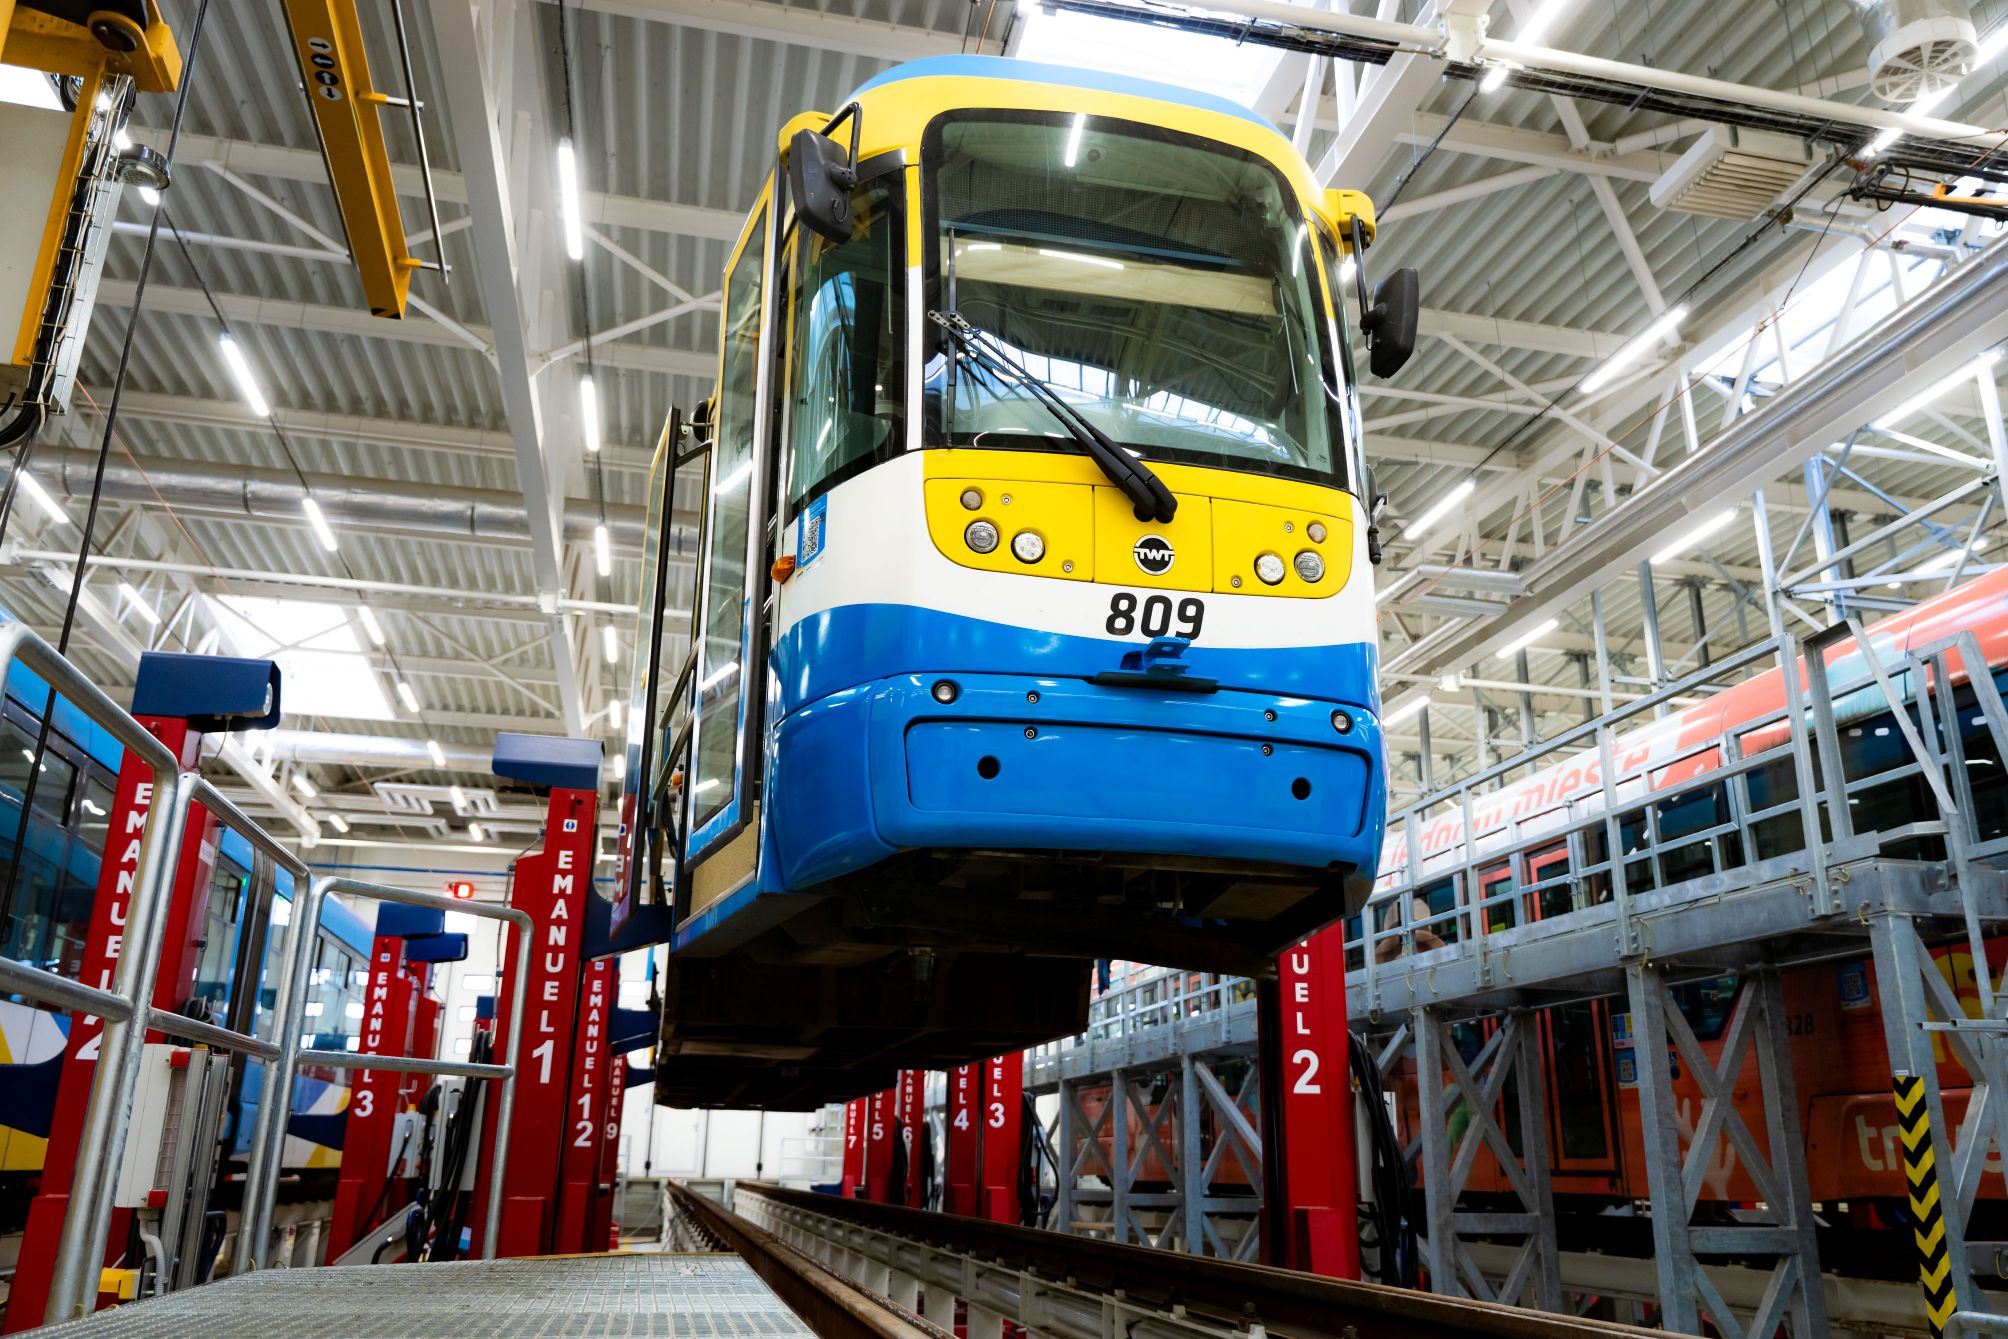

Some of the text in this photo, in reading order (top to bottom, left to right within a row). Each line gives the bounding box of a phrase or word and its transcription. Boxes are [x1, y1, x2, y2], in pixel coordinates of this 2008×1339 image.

[1133, 546, 1175, 562] TWT
[1105, 592, 1205, 640] 809
[532, 850, 573, 1084] EMANUEL 1
[583, 980, 602, 1088] EMANUEL
[1291, 940, 1321, 1094] UEL 2
[354, 972, 388, 1117] EMANUL 3
[606, 1055, 623, 1140] MANUEL 9
[953, 1107, 970, 1131] 4
[988, 1102, 1005, 1129] 3
[847, 1135, 857, 1149] 7
[872, 1123, 884, 1141] 5
